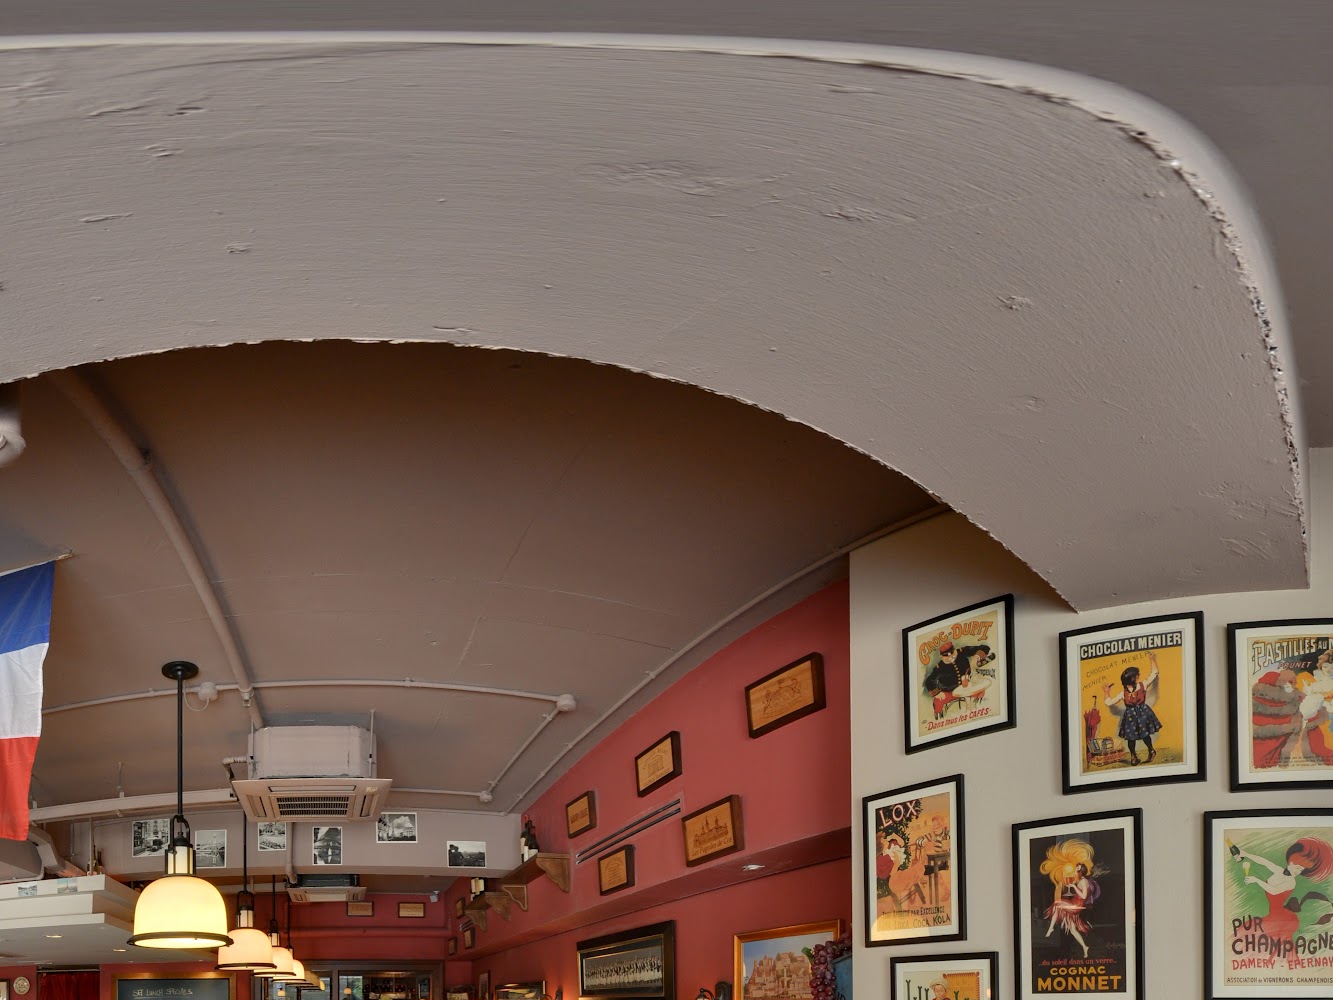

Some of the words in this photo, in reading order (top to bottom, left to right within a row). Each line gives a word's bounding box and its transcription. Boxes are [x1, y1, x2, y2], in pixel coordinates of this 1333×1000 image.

[1080, 638, 1136, 658] CHOCOLAT
[1138, 632, 1182, 650] MENIER
[1252, 638, 1316, 675] PASTILLES
[1318, 640, 1328, 650] AU
[1277, 661, 1312, 670] PRUNET
[879, 800, 918, 828] LOX
[1232, 914, 1264, 937] PUR
[1050, 965, 1106, 976] COGNAC
[1232, 958, 1276, 970] DAMERY
[1038, 975, 1122, 992] MONNET
